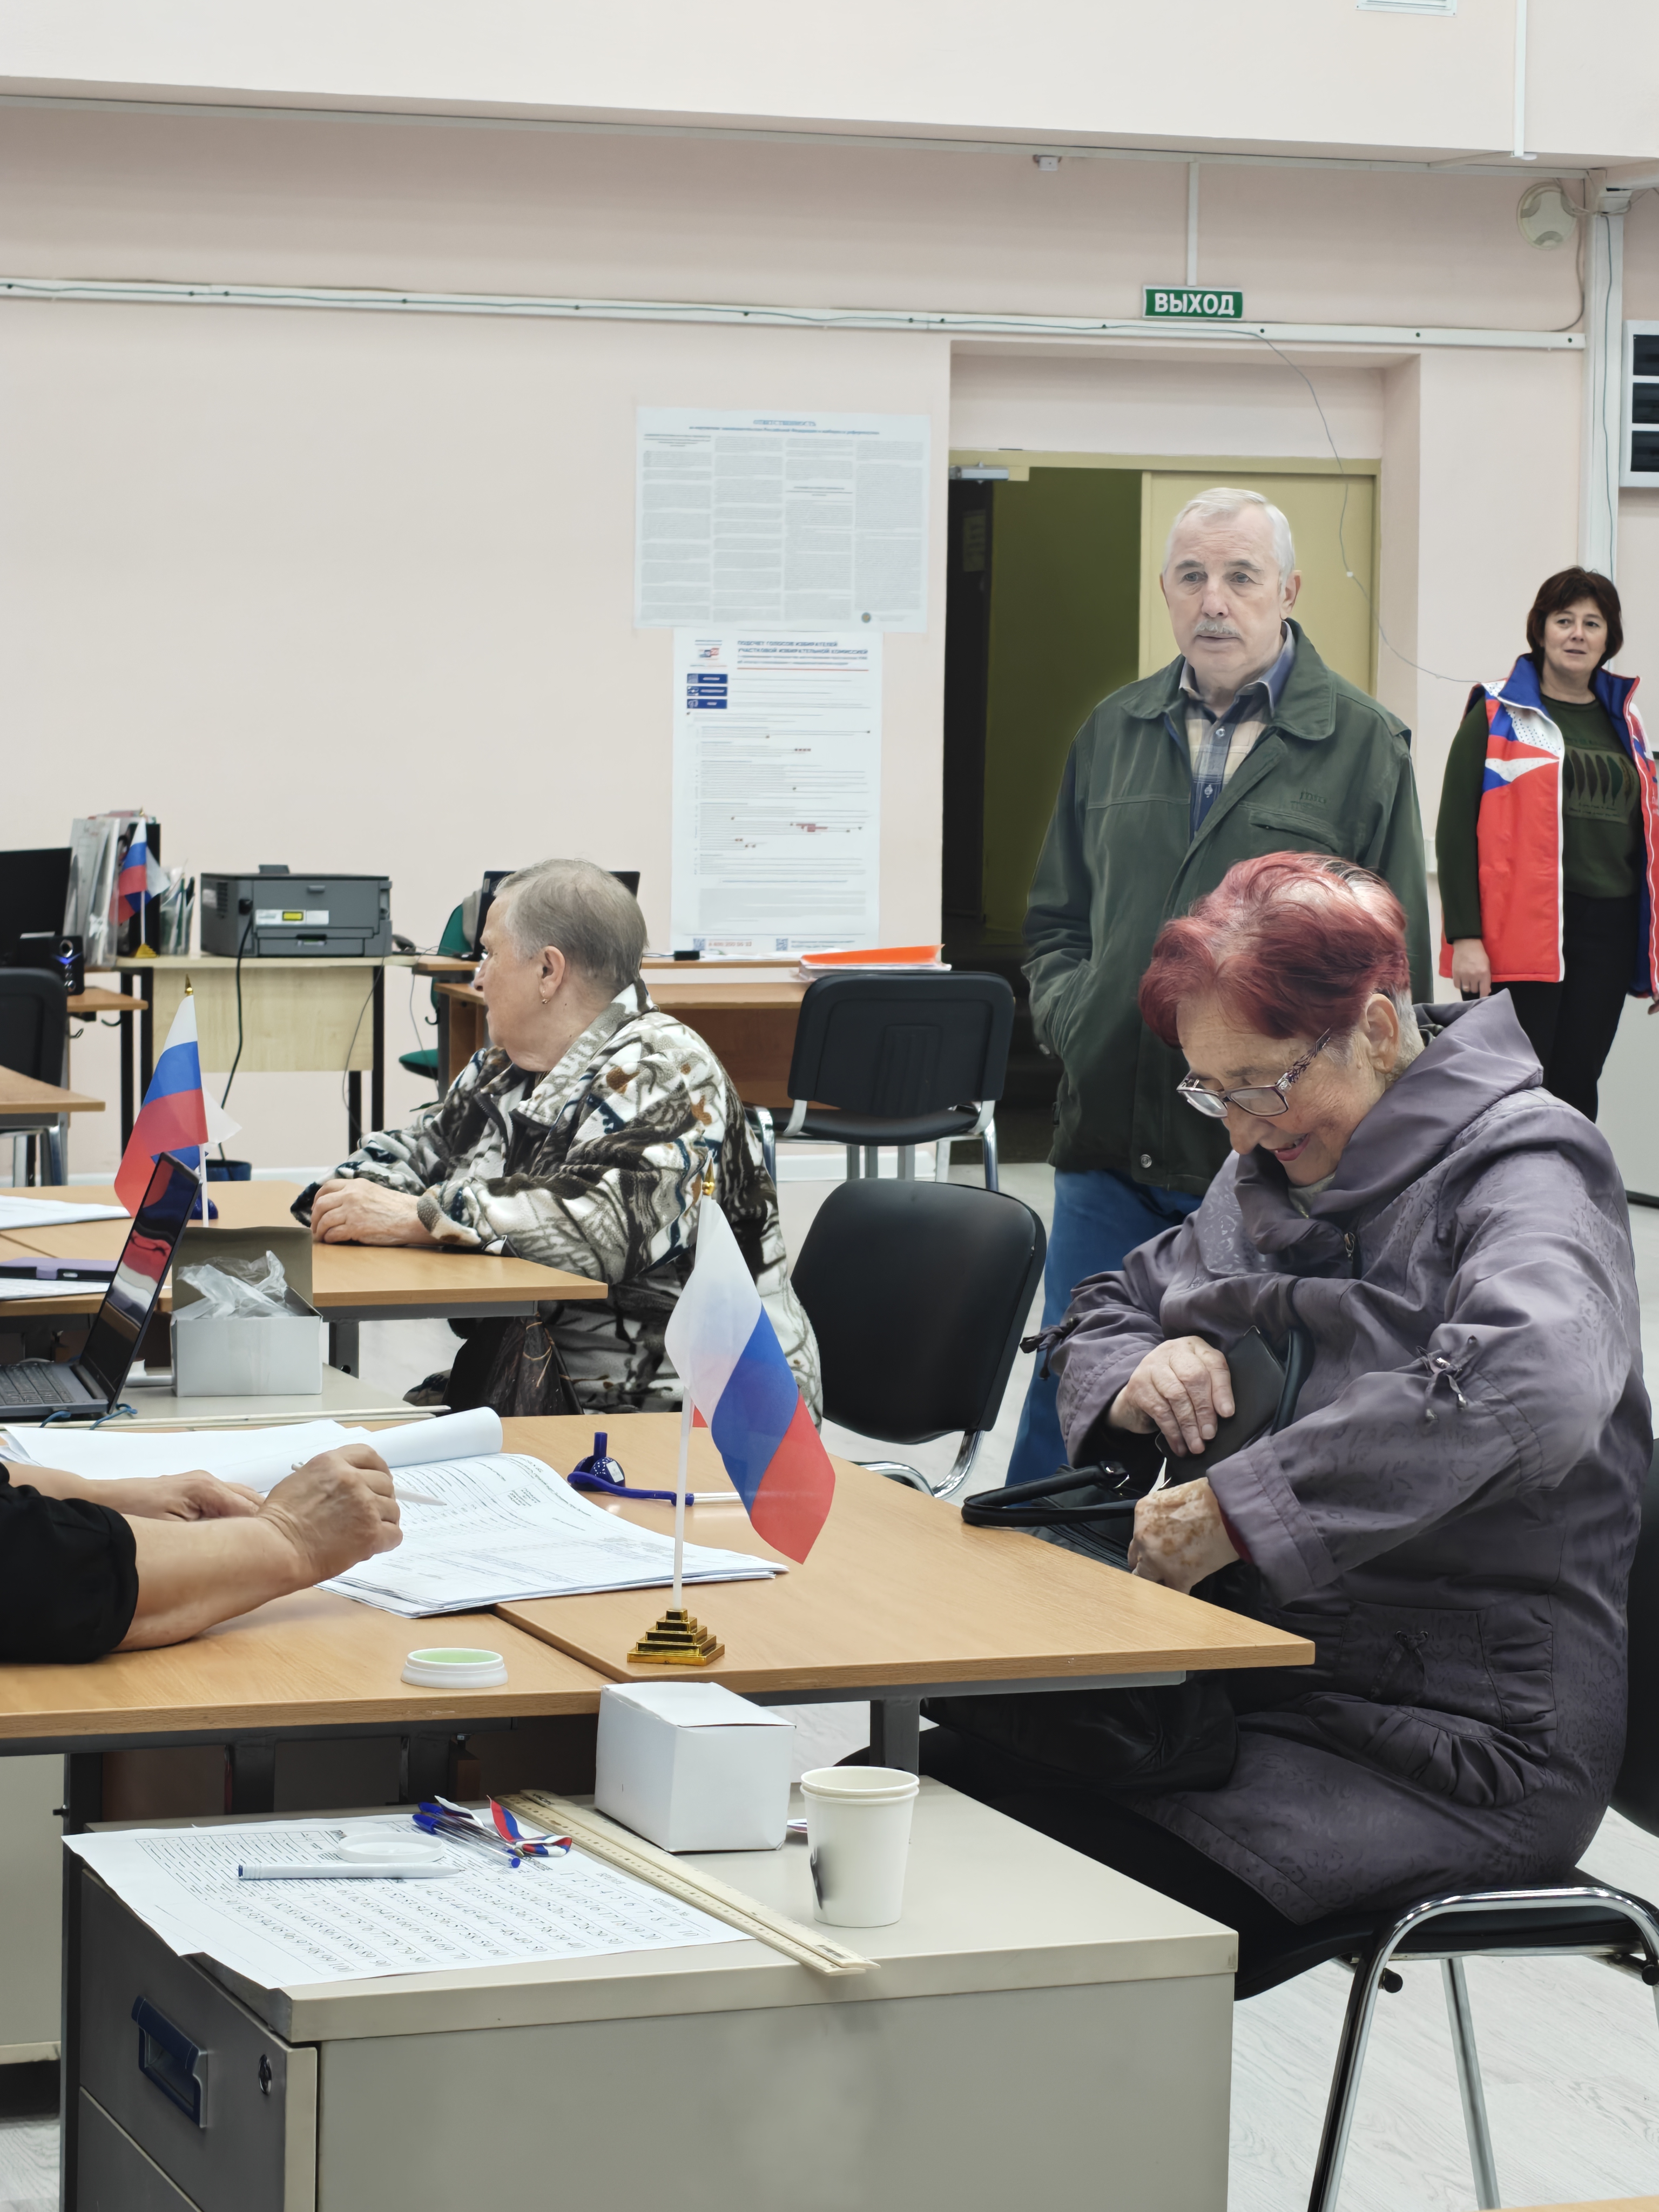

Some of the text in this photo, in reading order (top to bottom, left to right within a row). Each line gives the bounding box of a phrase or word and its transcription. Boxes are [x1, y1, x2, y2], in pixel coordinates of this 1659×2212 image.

[1154, 293, 1235, 316] ВЫХОД
[584, 1904, 606, 1912] 16
[310, 1899, 331, 1907] 72
[359, 1924, 378, 1932] 76
[381, 1938, 404, 1946] 78
[394, 1946, 417, 1955] 79
[498, 1928, 521, 1937] 48
[534, 1925, 558, 1933] 38
[571, 1922, 596, 1930] 28
[231, 1905, 254, 1913] 92
[267, 1925, 289, 1933] 95
[301, 1947, 326, 1955] 98
[316, 1954, 338, 1963] 99
[327, 1963, 355, 1973] 100
[293, 1914, 316, 1923] 84
[318, 1928, 338, 1936] 86
[342, 1942, 366, 1951] 88
[354, 1950, 378, 1958] 89
[368, 1959, 392, 1967] 90
[420, 1935, 443, 1943] 68
[433, 1943, 456, 1951] 69
[458, 1932, 482, 1940] 58
[471, 1940, 495, 1948] 59
